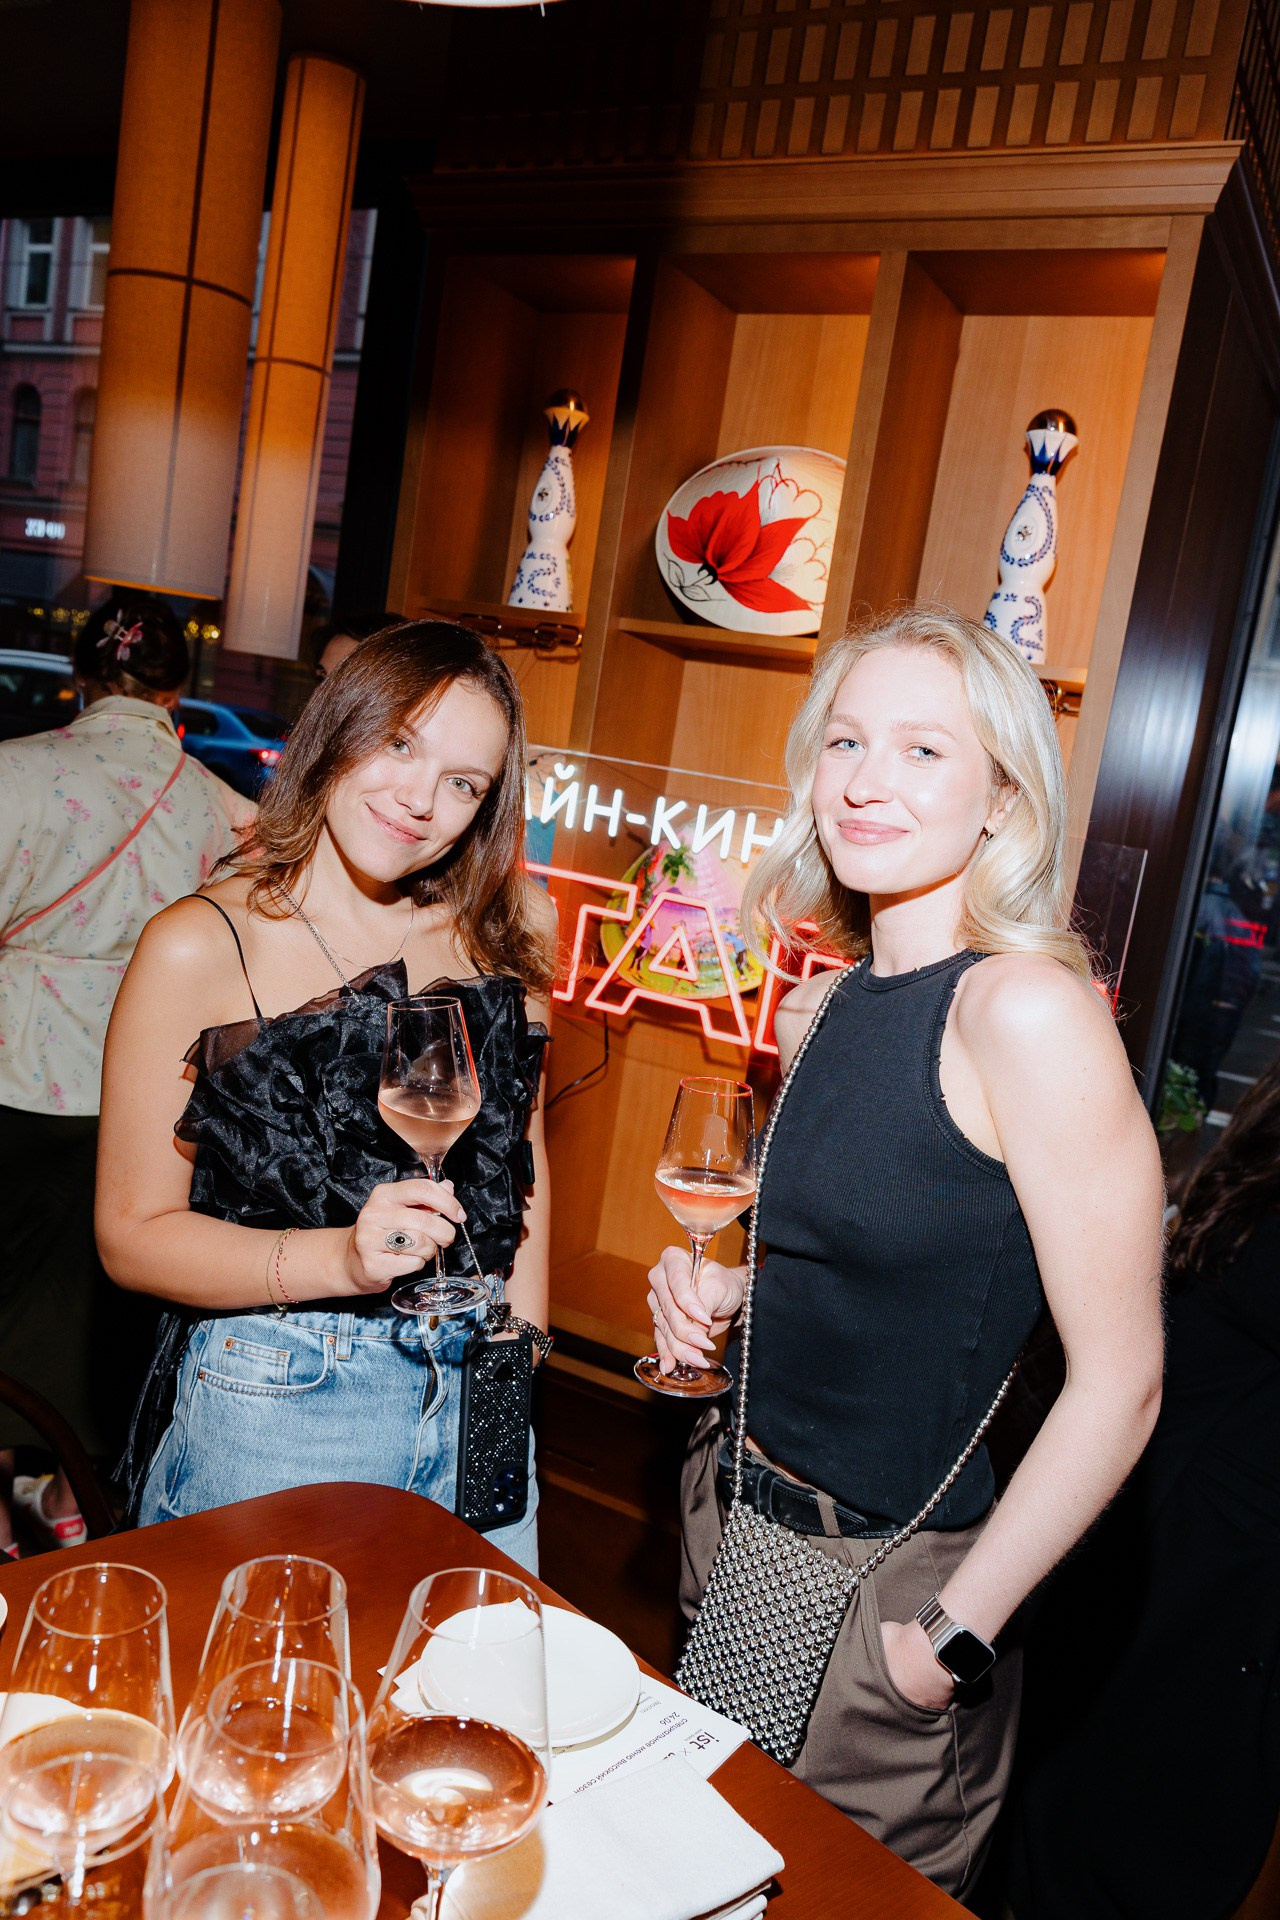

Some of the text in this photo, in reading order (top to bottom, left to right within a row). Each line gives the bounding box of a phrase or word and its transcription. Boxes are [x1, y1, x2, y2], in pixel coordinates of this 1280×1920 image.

[525, 762, 785, 863] ЙН-КИН
[644, 1718, 688, 1748] специальное
[689, 1731, 720, 1750] ist
[625, 1745, 646, 1762] меню
[595, 1758, 627, 1782] высокий
[573, 1778, 597, 1794] сезон
